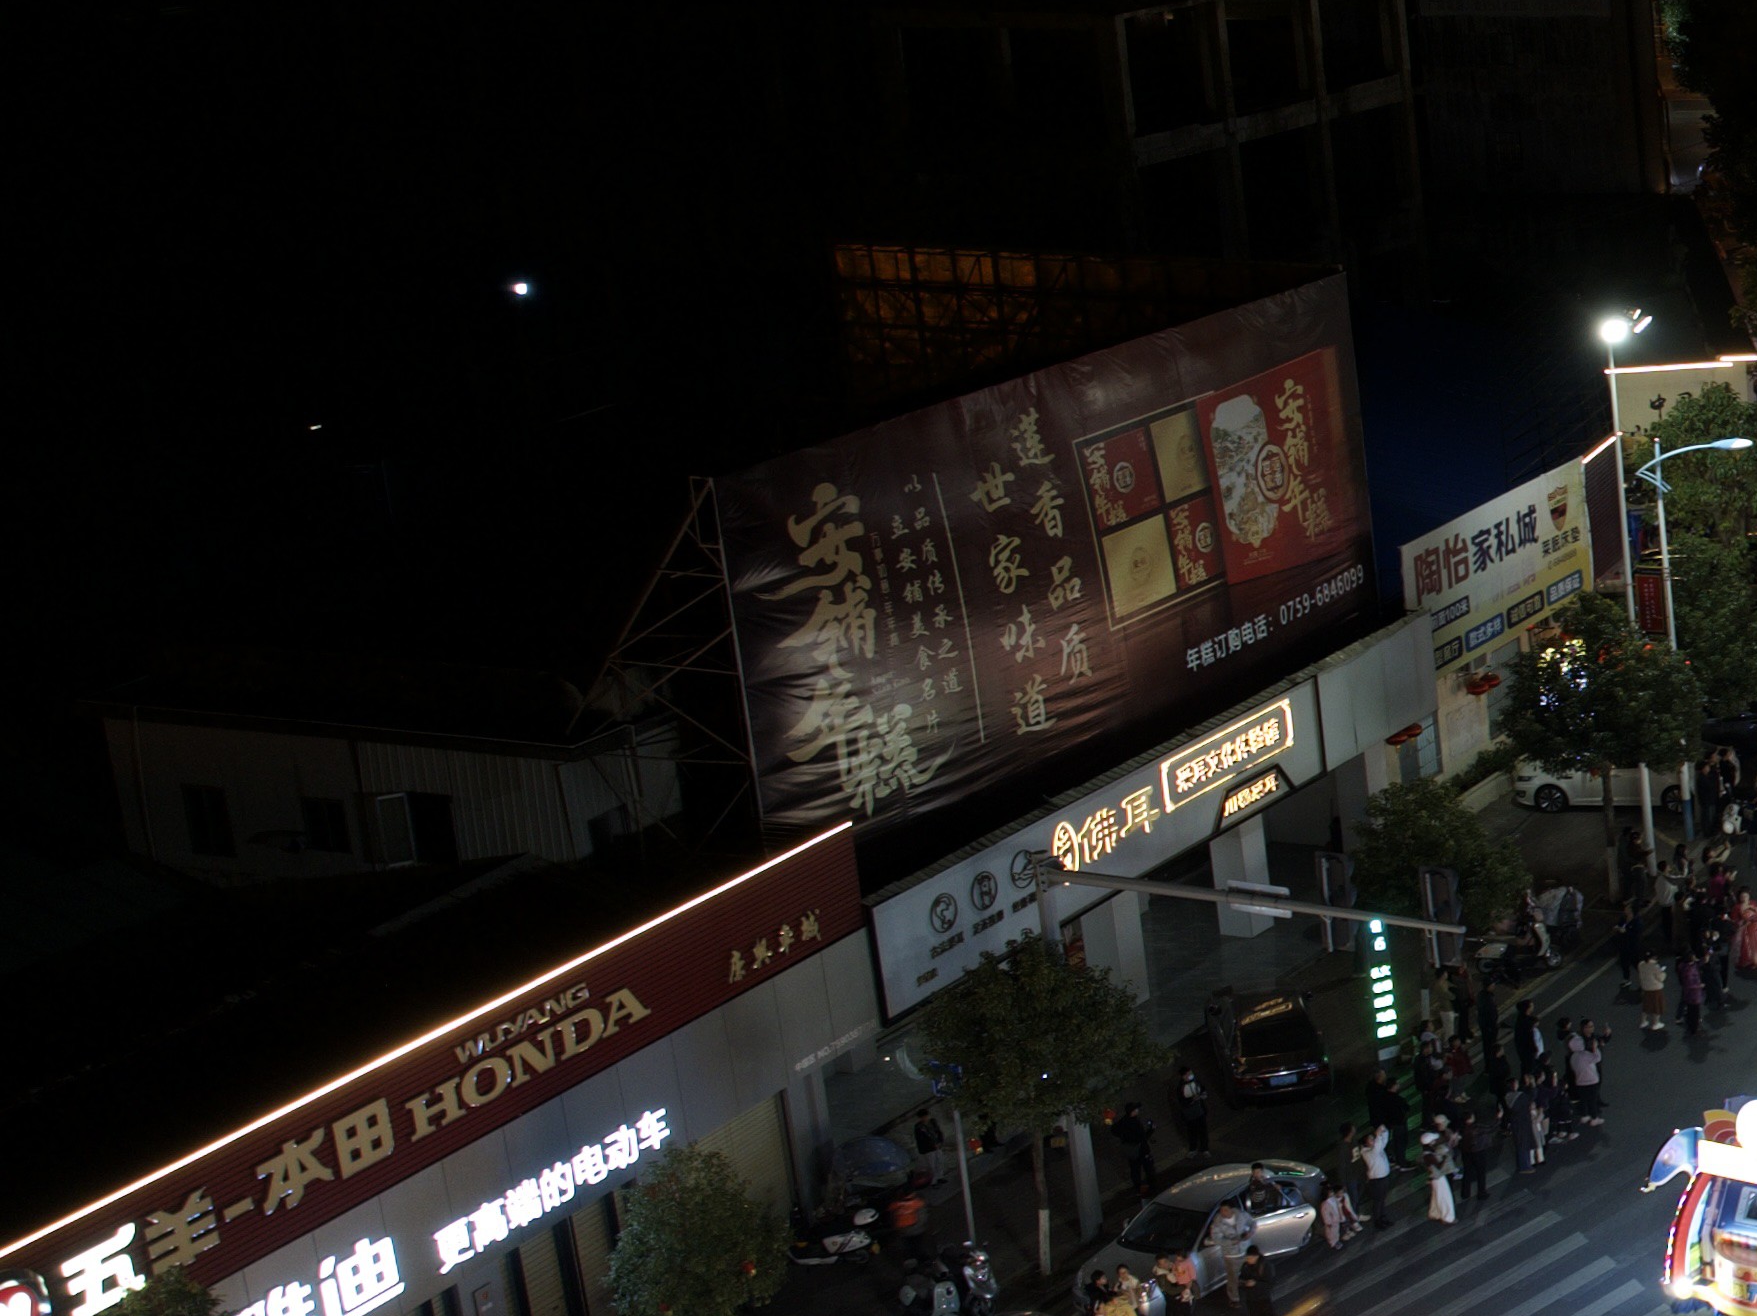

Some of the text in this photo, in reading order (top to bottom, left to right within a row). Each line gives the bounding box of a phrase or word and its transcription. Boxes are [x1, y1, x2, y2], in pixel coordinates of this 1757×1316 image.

[754, 481, 956, 818] 安铺年糕
[890, 513, 941, 734] 立安铺美食名片
[903, 474, 964, 696] 以品质传承之道
[970, 462, 1058, 737] 世家味道
[1011, 406, 1093, 684] 莲香品质
[1413, 504, 1539, 606] 陶怡家私城
[407, 987, 652, 1142] HONDA
[454, 982, 590, 1065] WUYANG
[432, 1108, 671, 1275] 更高端的电动车
